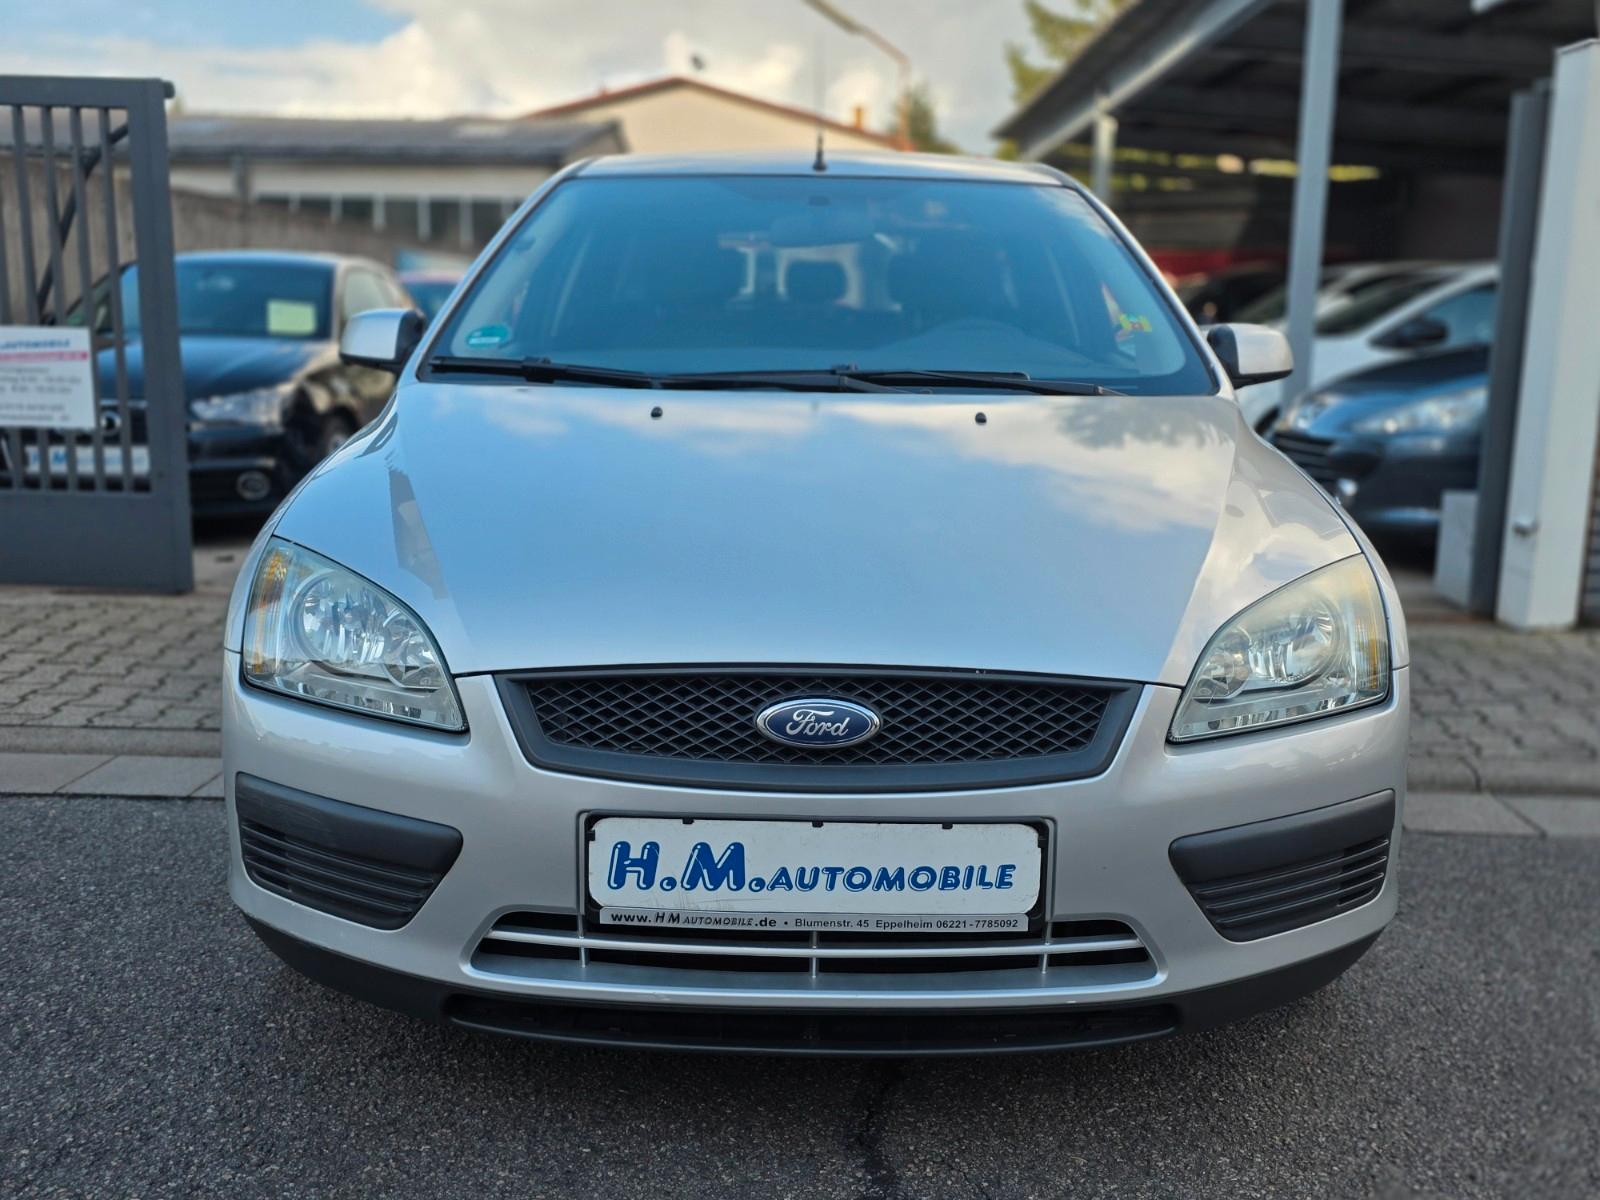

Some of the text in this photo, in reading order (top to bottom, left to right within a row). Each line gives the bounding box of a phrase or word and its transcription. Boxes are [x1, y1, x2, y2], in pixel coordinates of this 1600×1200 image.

[786, 709, 850, 735] Ford
[794, 918, 854, 928] Blumenstr.
[856, 919, 870, 928] 45
[875, 919, 933, 929] Eppelheim
